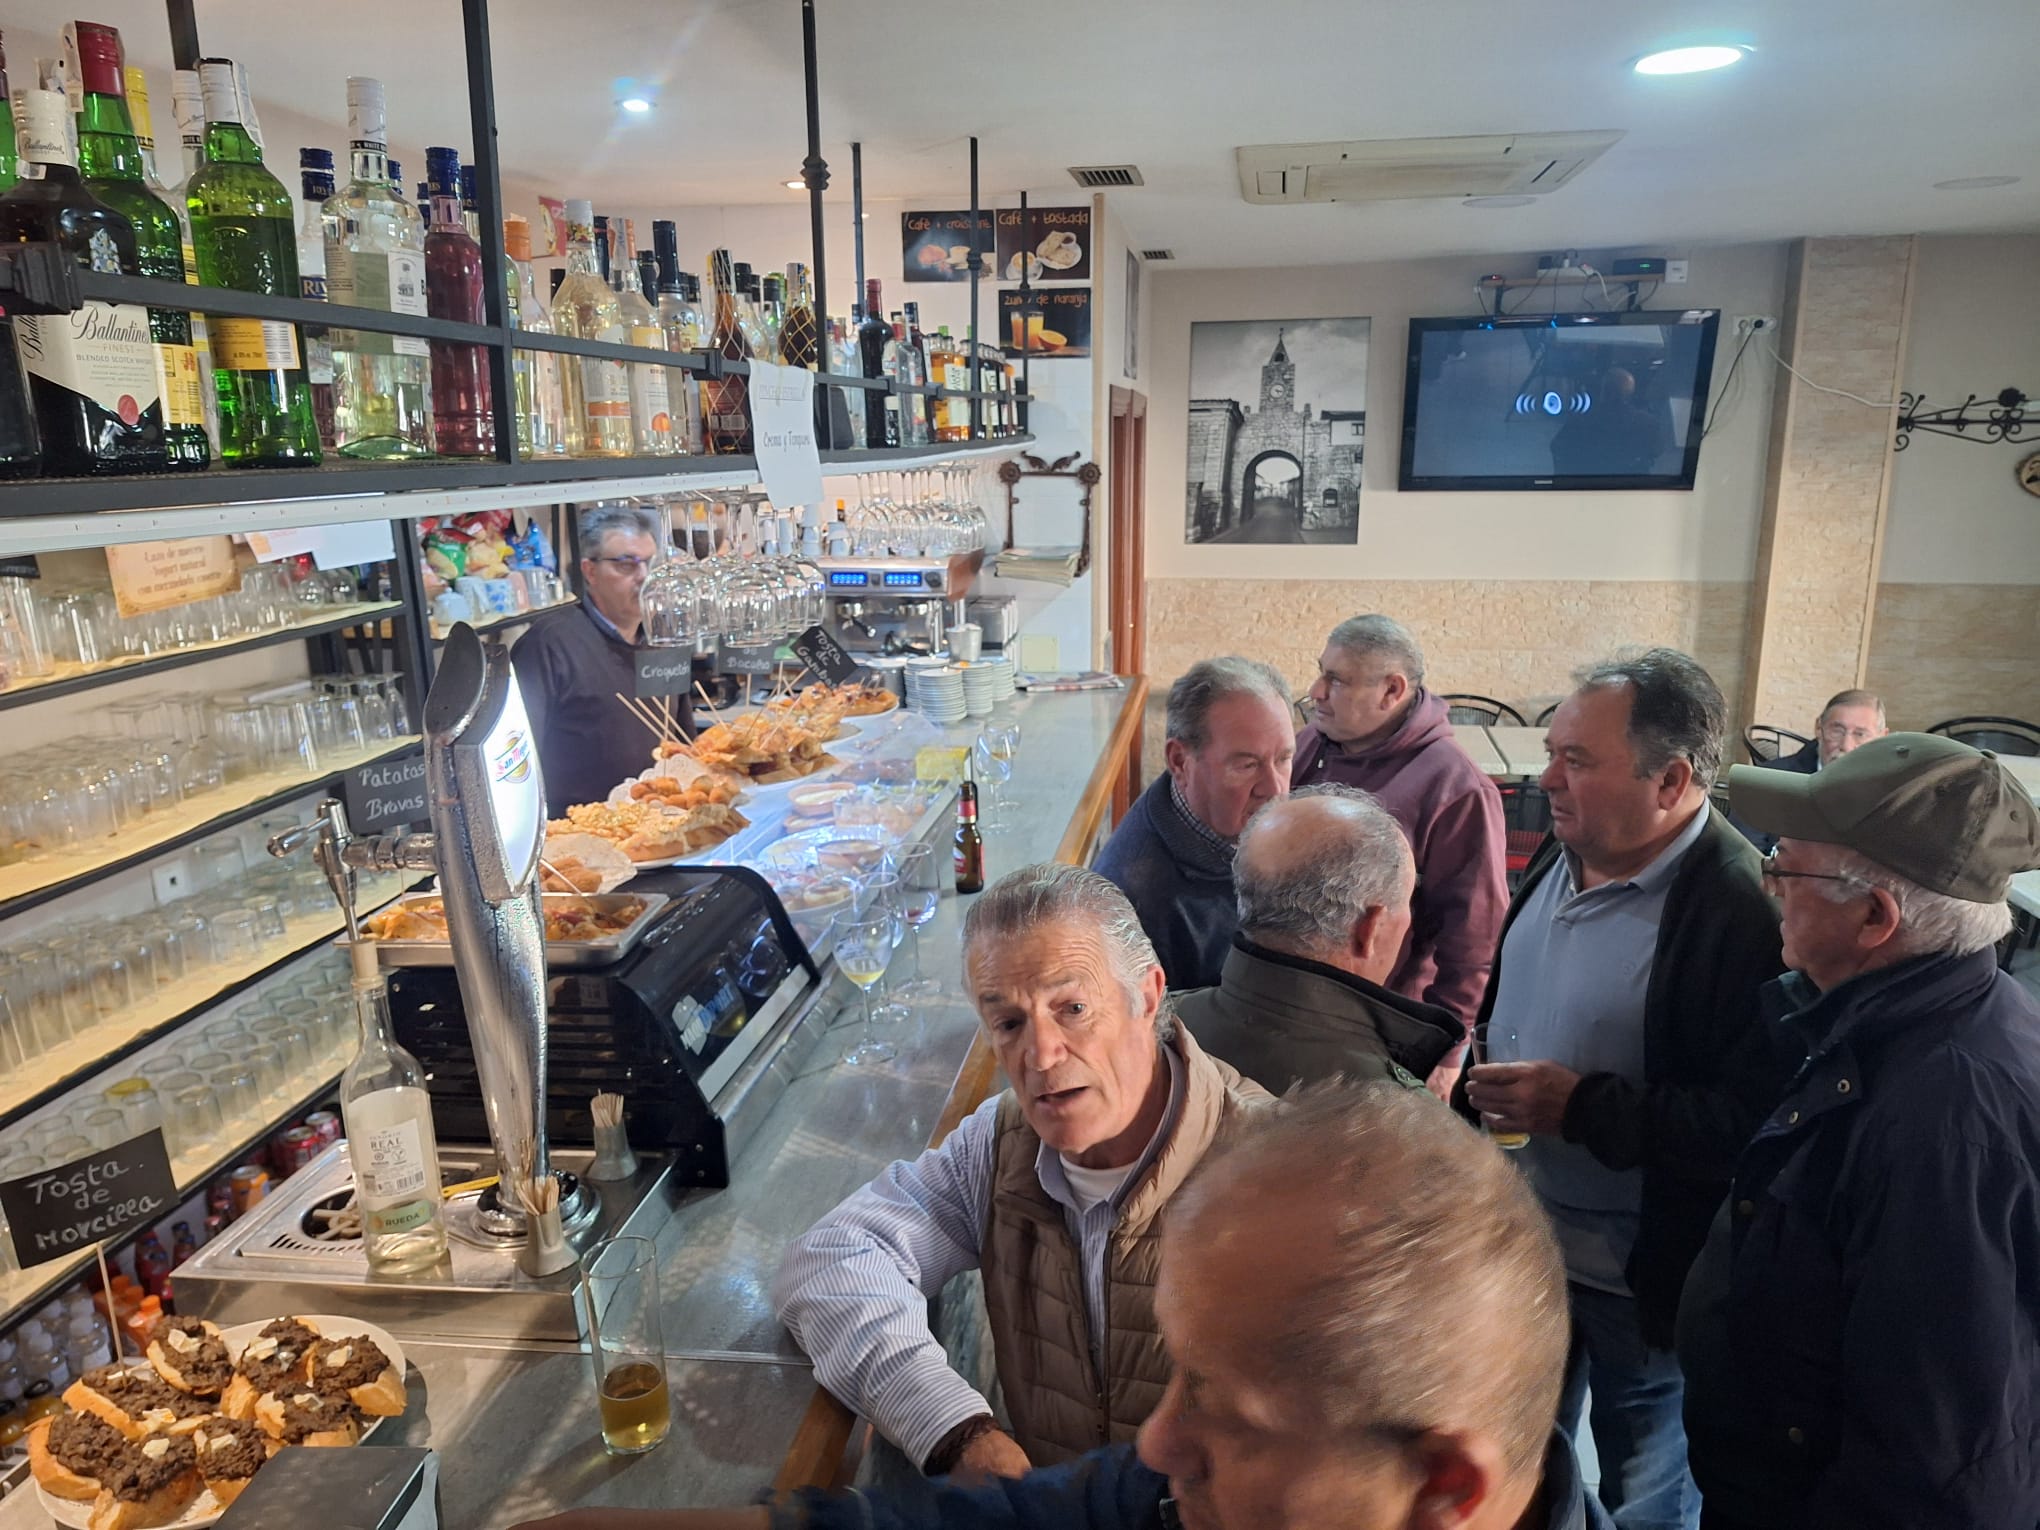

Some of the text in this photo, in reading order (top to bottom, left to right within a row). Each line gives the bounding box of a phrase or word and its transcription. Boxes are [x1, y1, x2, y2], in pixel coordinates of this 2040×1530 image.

[908, 218, 931, 231] Café
[946, 218, 992, 230] croisnt
[999, 211, 1023, 225] Café
[1043, 210, 1088, 226] tostada
[1036, 294, 1048, 305] de
[1054, 293, 1087, 308] naranja
[103, 343, 134, 352] FINEST
[76, 354, 110, 362] BLENDED
[111, 356, 134, 364] SCOTCH
[358, 763, 426, 788] Patatas
[370, 1138, 402, 1150] REAL
[25, 1160, 130, 1204] Tosta
[74, 1187, 111, 1210] de
[385, 1212, 420, 1227] RUEDA
